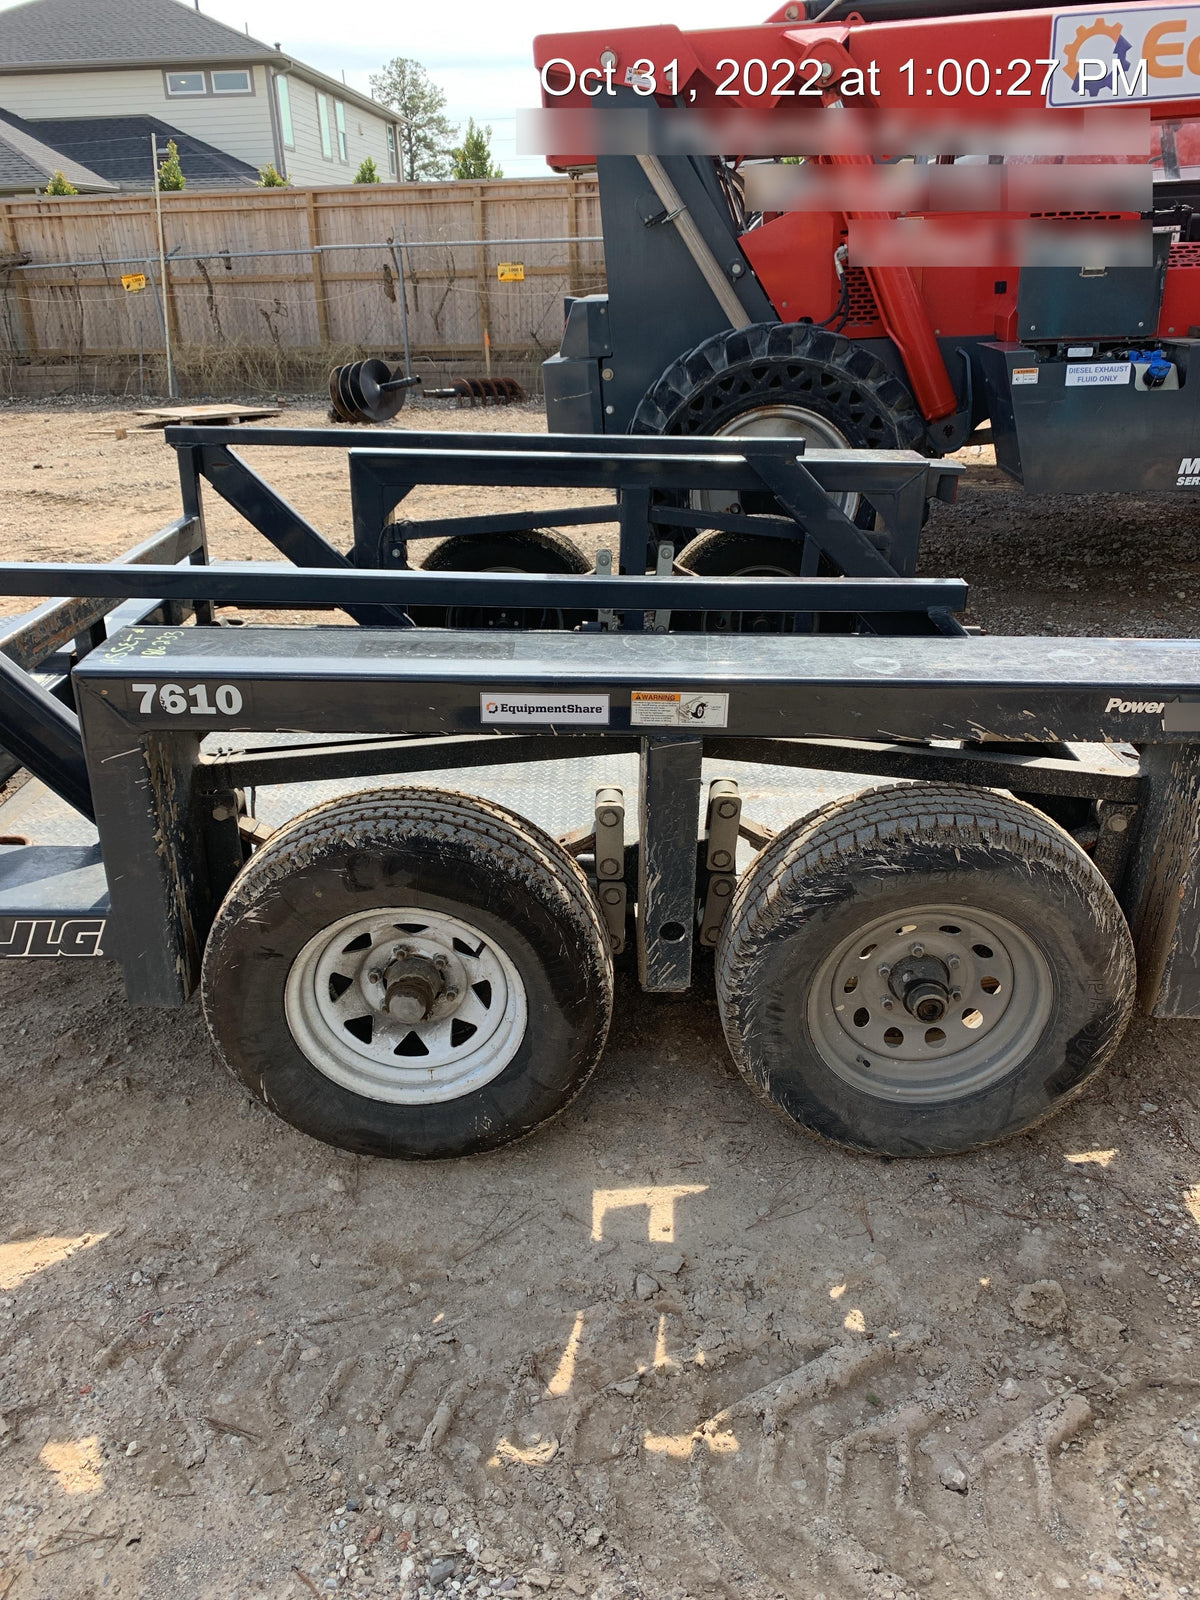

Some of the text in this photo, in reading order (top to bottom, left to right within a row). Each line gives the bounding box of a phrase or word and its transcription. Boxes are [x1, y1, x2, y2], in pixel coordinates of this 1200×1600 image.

[1068, 365, 1129, 375] DIESEL EXHAUST
[1077, 375, 1098, 383] FLUID
[131, 683, 243, 716] 7610
[500, 703, 603, 715] EquipmentShare
[0, 919, 107, 957] JLG
